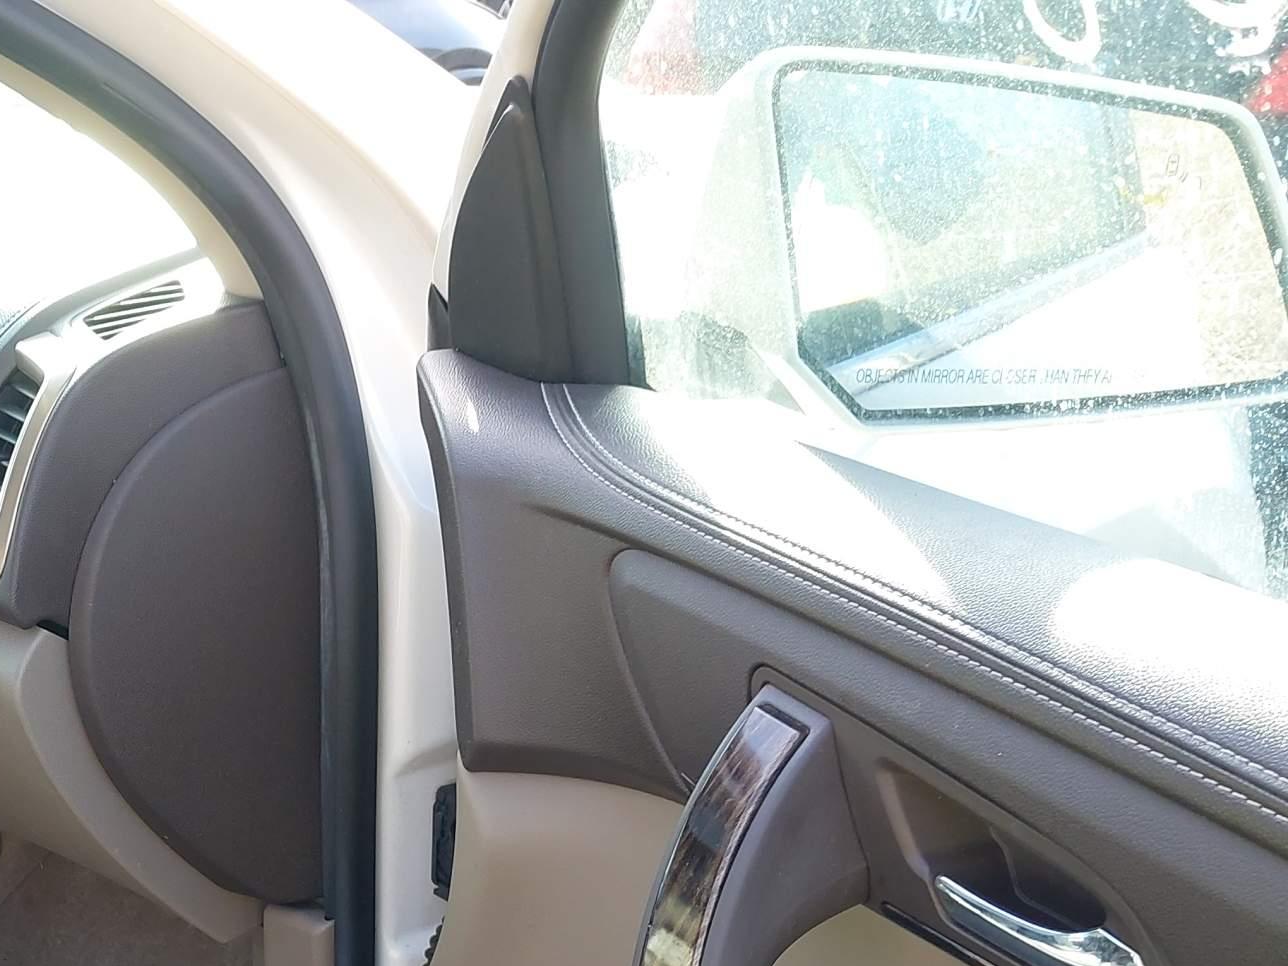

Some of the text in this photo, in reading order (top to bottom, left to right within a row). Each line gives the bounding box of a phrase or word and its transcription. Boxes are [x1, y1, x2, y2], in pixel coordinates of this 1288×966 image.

[856, 367, 905, 385] OBJECTS
[907, 367, 920, 385] IN
[921, 367, 965, 385] MIRROR
[966, 367, 990, 384] ARE
